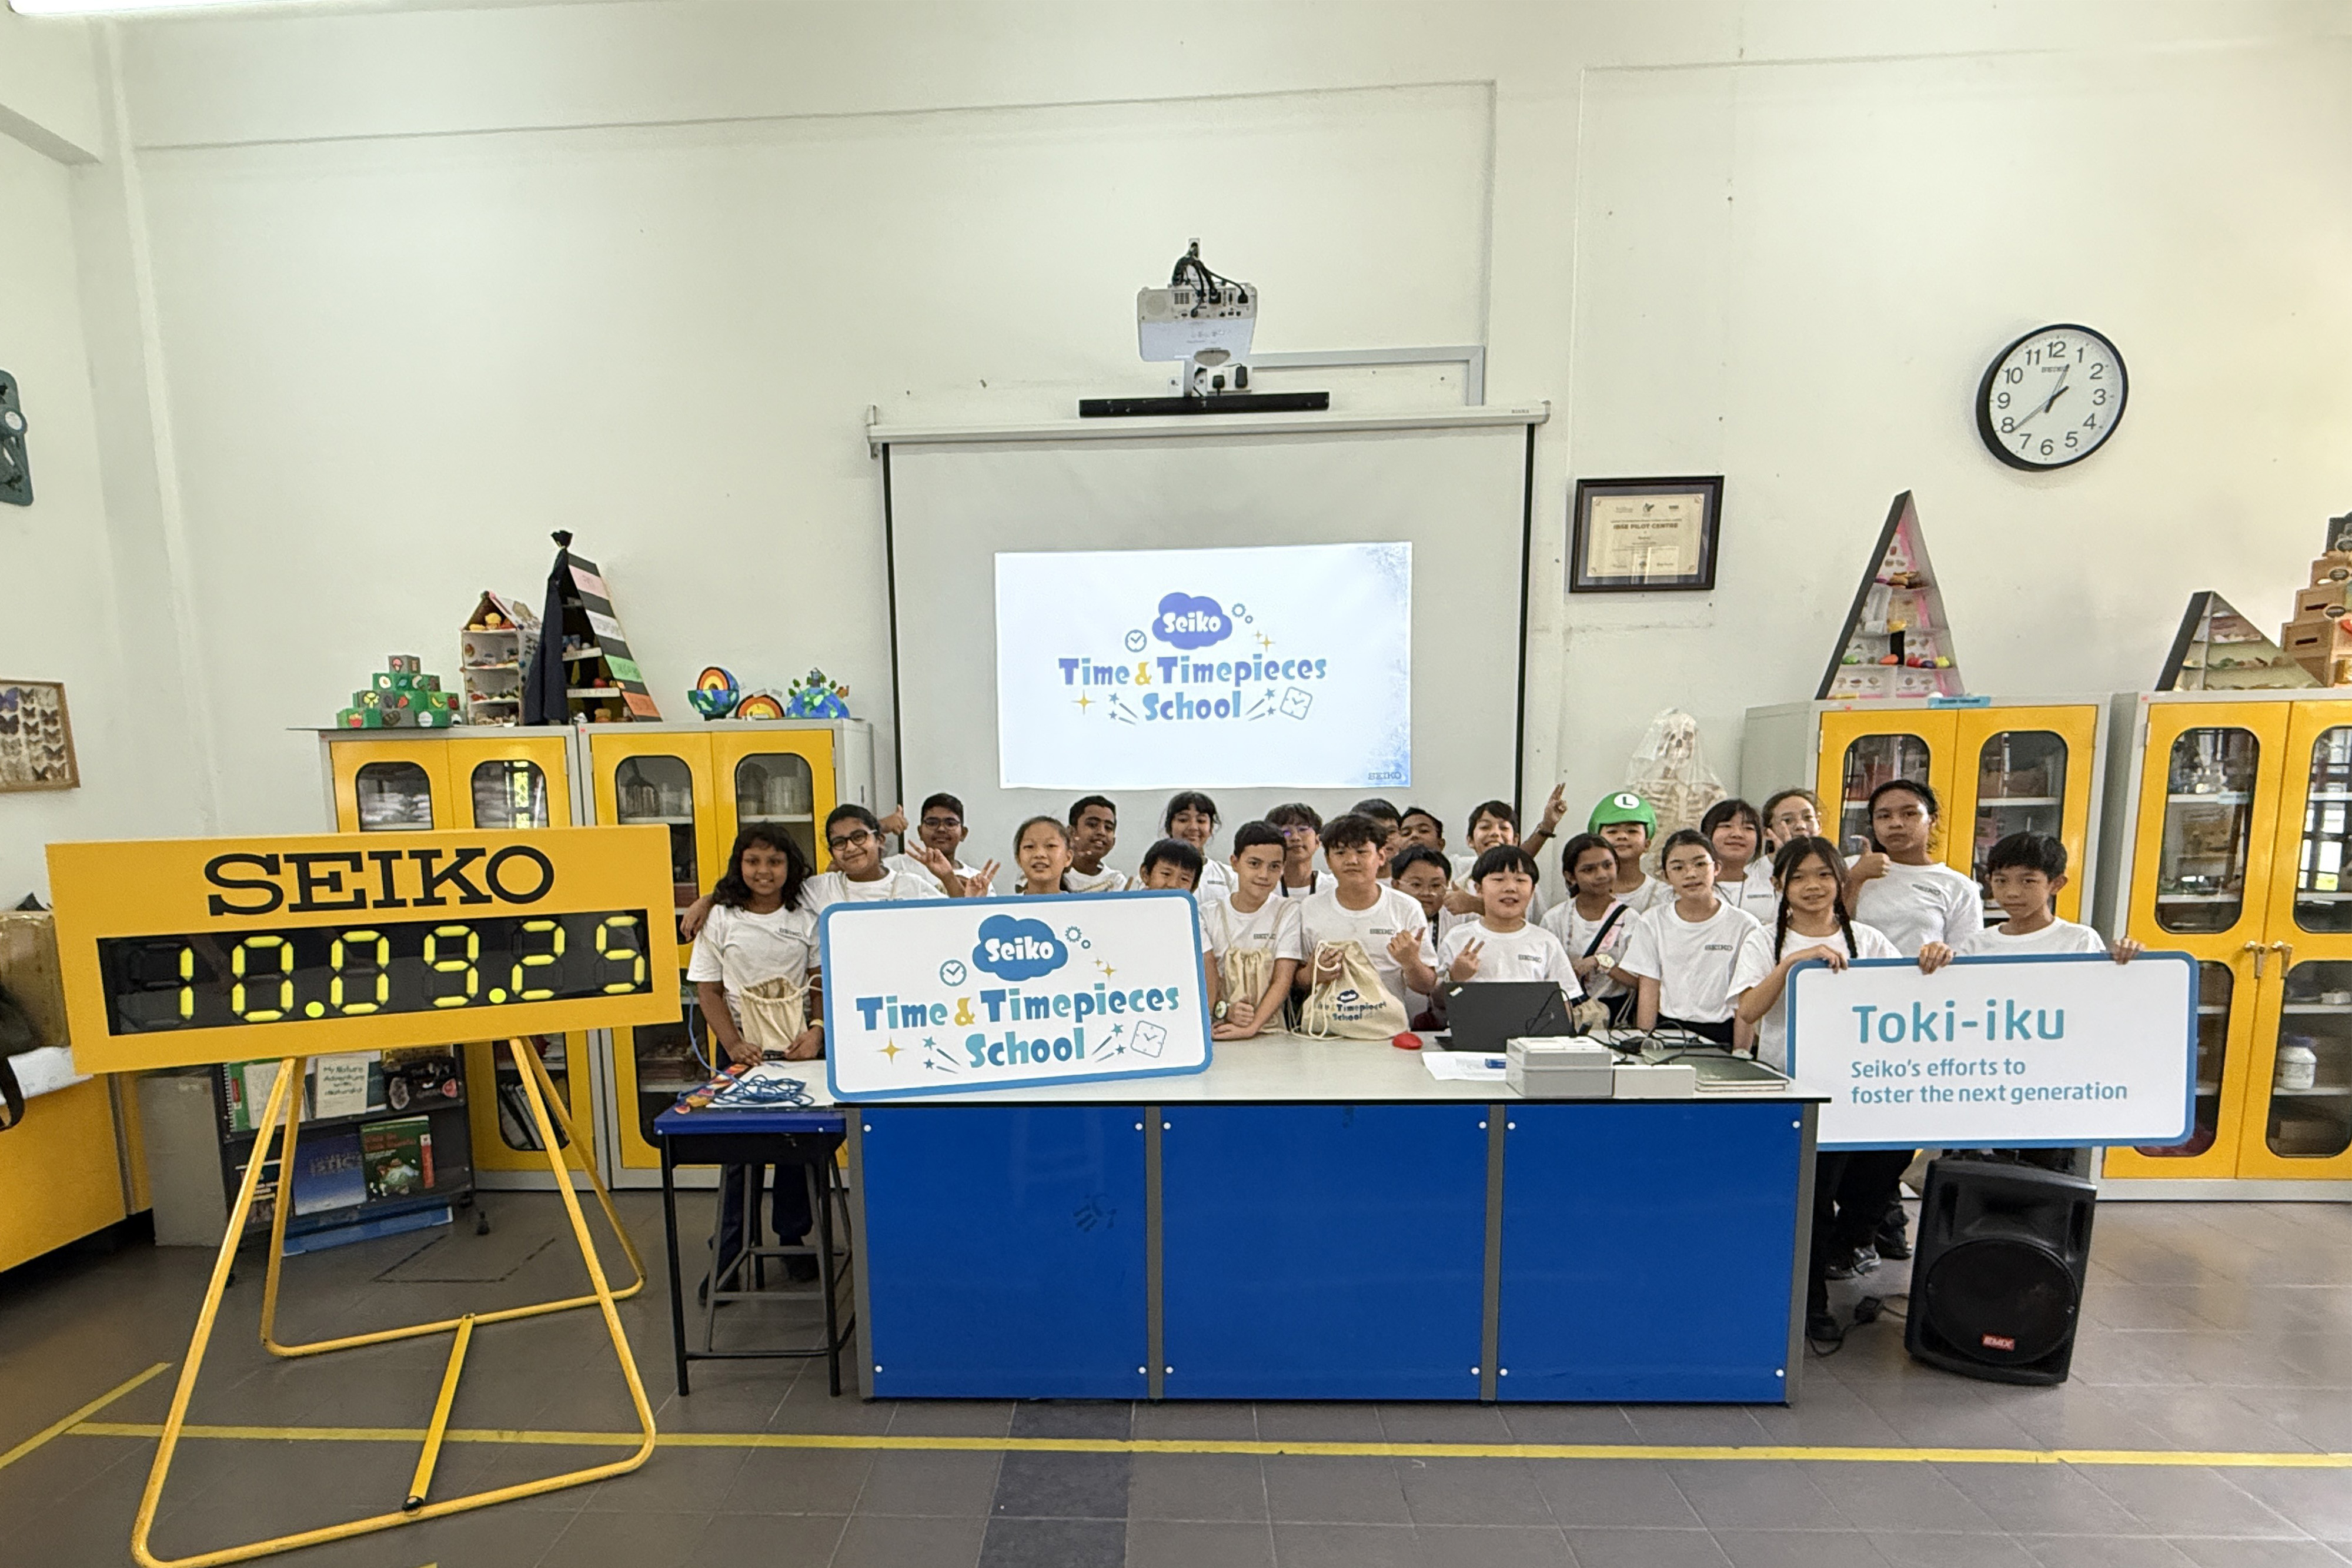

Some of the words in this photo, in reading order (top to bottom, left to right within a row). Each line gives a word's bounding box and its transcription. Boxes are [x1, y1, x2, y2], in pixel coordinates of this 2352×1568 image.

[2026, 349, 2040, 366] 11
[2047, 341, 2066, 358] 12
[2077, 347, 2083, 363] 1
[2004, 367, 2023, 384] 10
[2090, 363, 2103, 379] 2
[1997, 392, 2010, 409] 9
[2092, 389, 2106, 405] 3
[2000, 417, 2014, 433] 8
[2083, 413, 2097, 430] 4
[2019, 433, 2032, 449] 7
[2040, 439, 2053, 456] 6
[2064, 431, 2079, 448] 5
[1162, 611, 1222, 634] Seiko
[1058, 658, 1130, 686] Time
[1134, 661, 1152, 686] &
[1157, 654, 1327, 687] Timepieces
[1142, 691, 1241, 721] School
[1368, 771, 1402, 780] SEIKO
[1623, 796, 1633, 806] L
[203, 845, 554, 917] SEIKO
[985, 936, 1054, 962] Seiko
[856, 995, 948, 1030] Time
[954, 997, 975, 1027] &
[980, 984, 1179, 1023] Timepieces
[1332, 1012, 1362, 1021] School
[1852, 998, 2065, 1044] Toki-iku
[965, 1027, 1085, 1068] School
[1851, 1059, 1921, 1078] Seiko's
[1927, 1058, 1998, 1077] efforts
[2003, 1058, 2026, 1075] to
[1851, 1086, 1914, 1104] foster
[1920, 1085, 1954, 1102] the
[1959, 1084, 2006, 1102] next
[2011, 1081, 2127, 1105] generation
